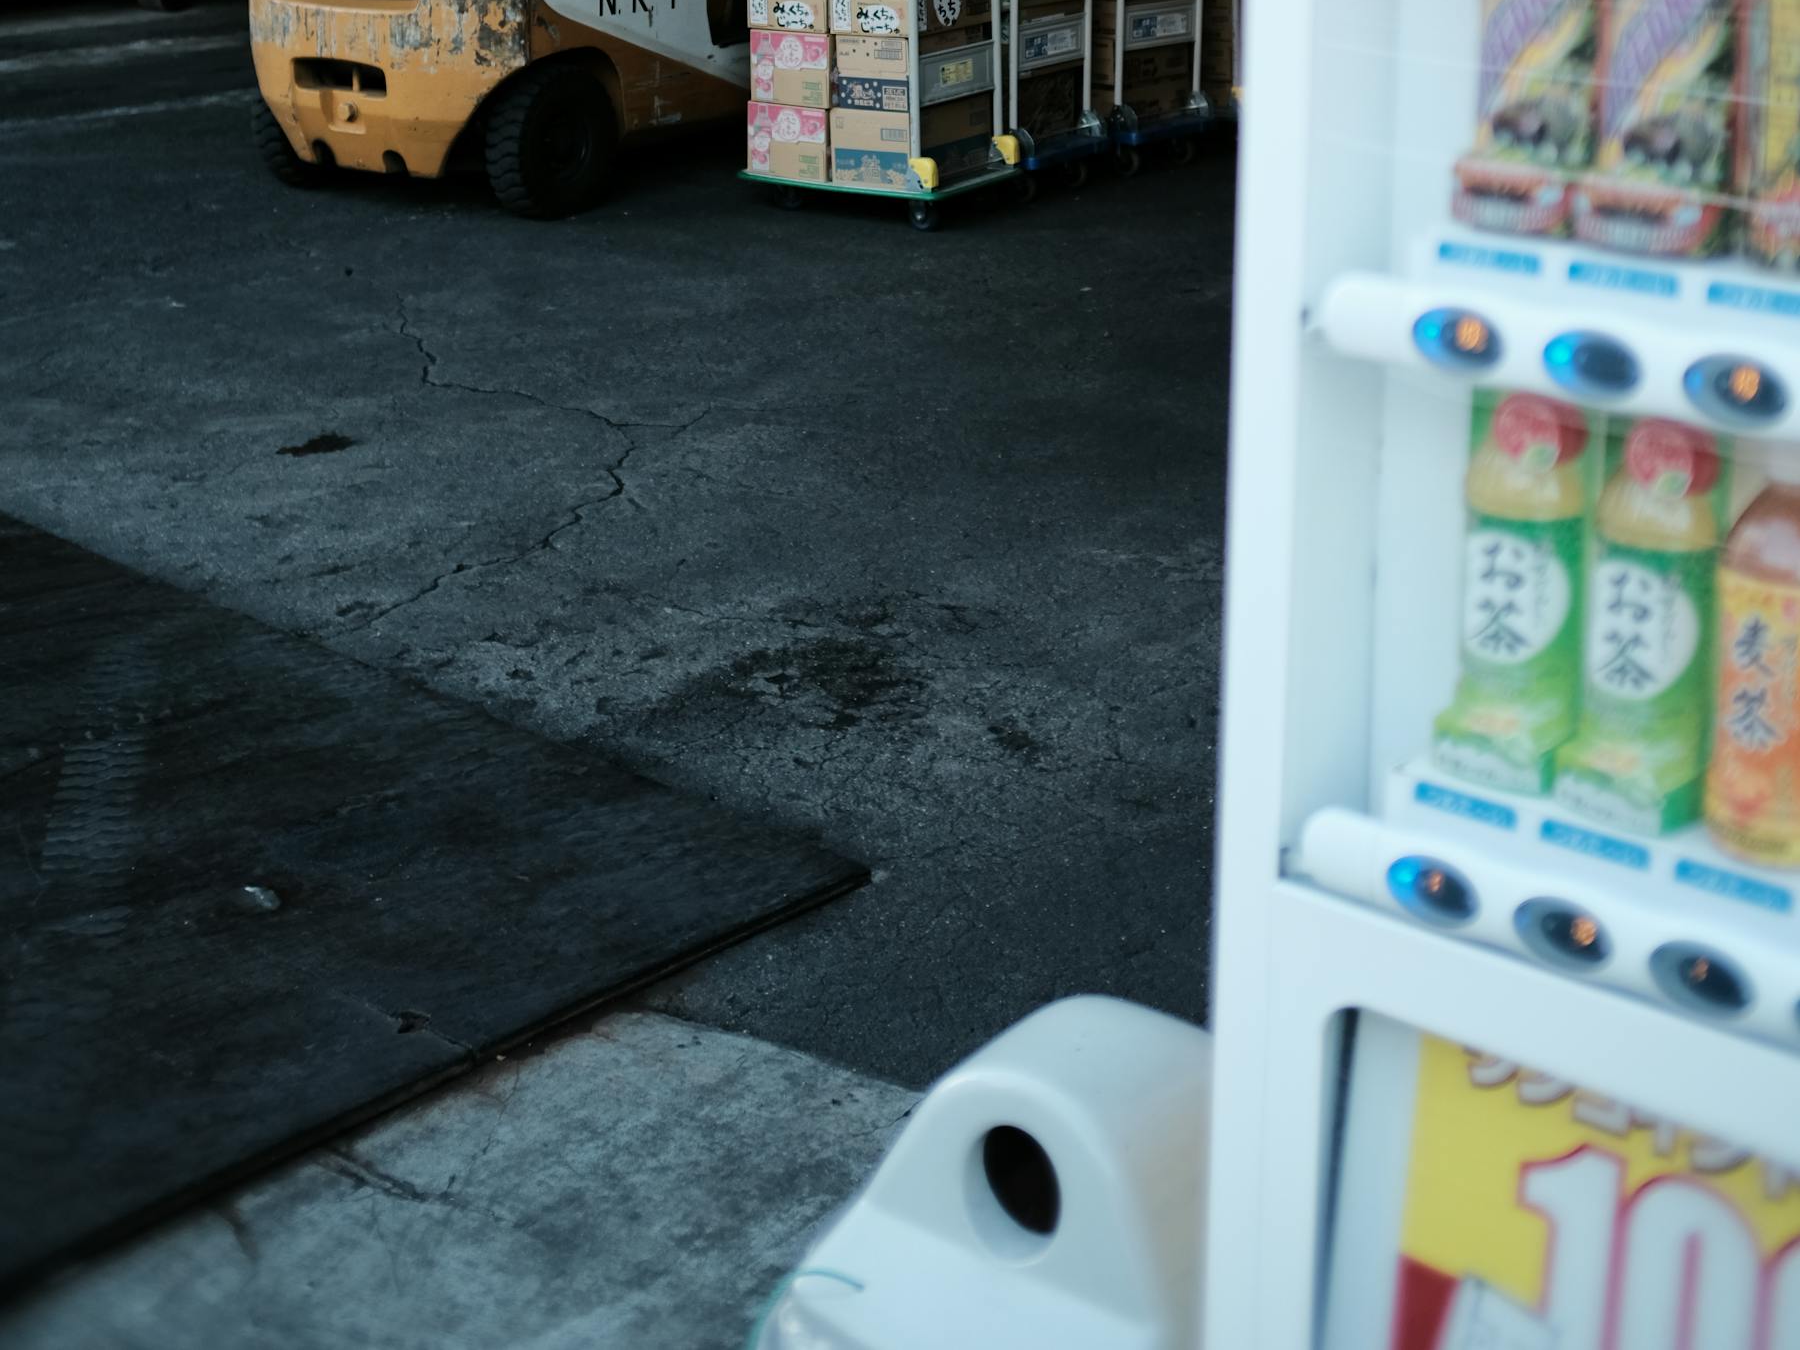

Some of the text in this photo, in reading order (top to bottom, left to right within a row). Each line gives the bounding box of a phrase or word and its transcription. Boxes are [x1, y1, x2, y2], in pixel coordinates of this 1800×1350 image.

[1467, 540, 1531, 656] お茶
[1595, 569, 1657, 693] お茶
[1726, 613, 1783, 753] 麦茶
[1515, 1141, 1800, 1350] 10
